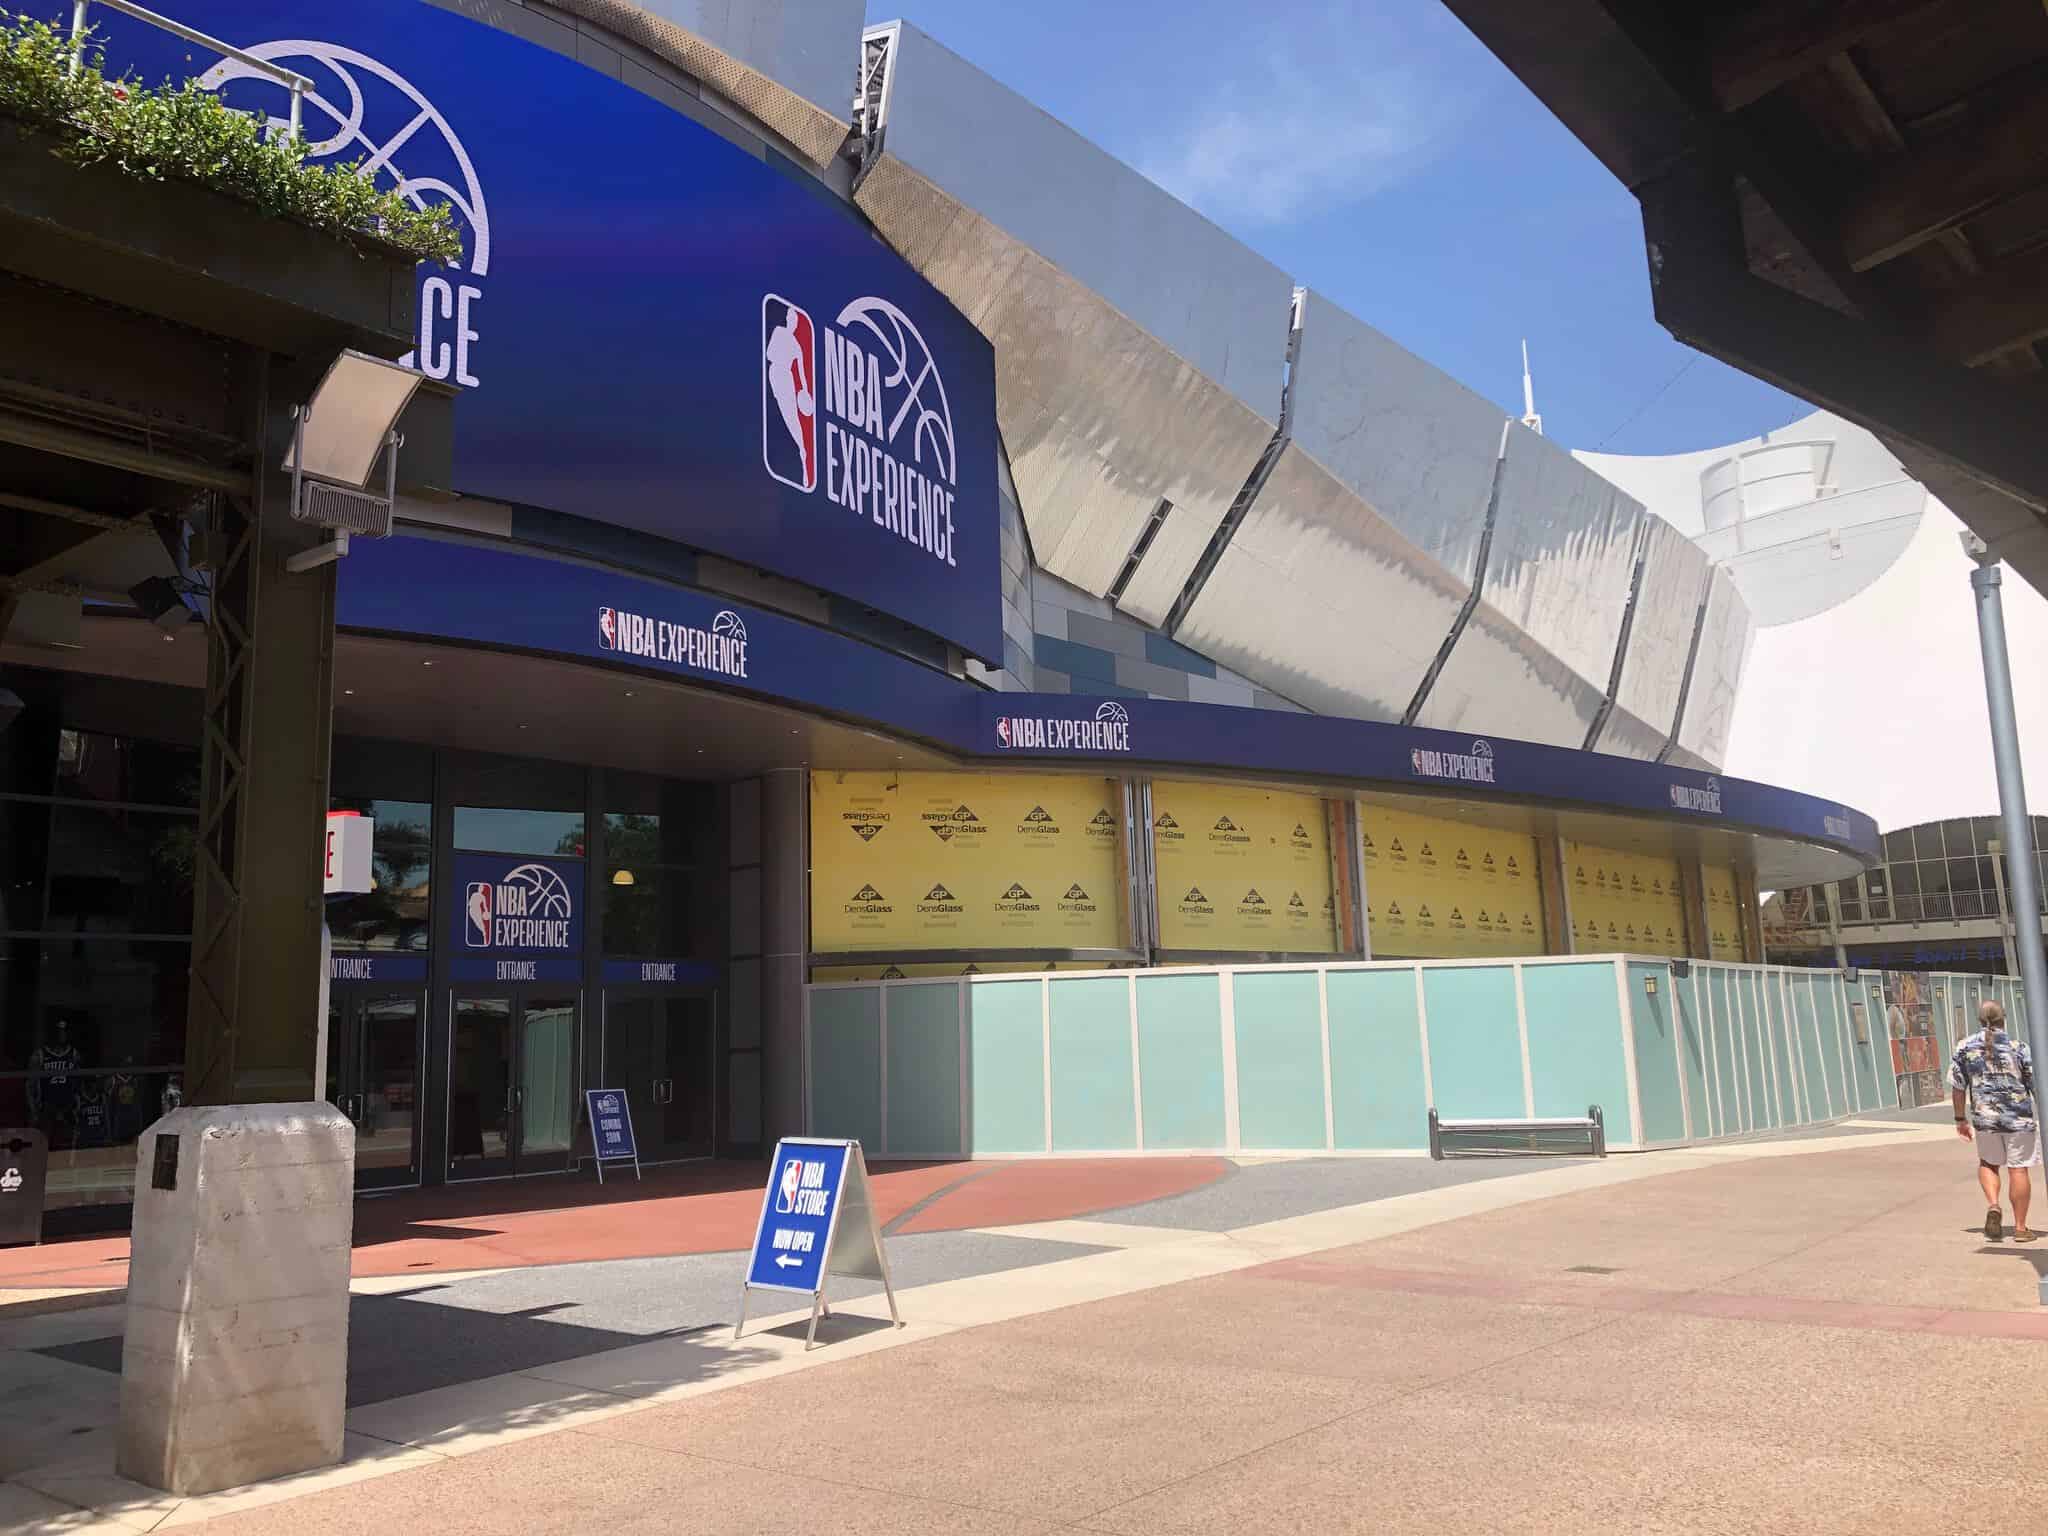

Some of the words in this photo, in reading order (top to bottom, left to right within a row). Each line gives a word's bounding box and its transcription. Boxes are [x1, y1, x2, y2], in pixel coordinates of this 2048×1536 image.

[398, 276, 481, 387] CE
[825, 326, 884, 441] NBA
[826, 421, 956, 567] EXPERIENCE
[617, 612, 656, 658] NBA
[658, 621, 748, 678] EXPERIENCE
[1012, 718, 1047, 748] NBA
[1048, 720, 1130, 750] EXPERIENCE
[1421, 750, 1443, 777] NBA
[1442, 752, 1496, 783] EXPERIENCE
[495, 885, 528, 916] NBA
[844, 903, 893, 913] DensGlass
[916, 903, 963, 913] DensGlass
[994, 903, 1040, 912] DensGlass
[495, 918, 569, 948] EXPERIENCE
[330, 958, 373, 979] NTRANCE
[496, 961, 537, 980] ENTRANCE
[641, 963, 677, 981] ENTRANCE
[800, 1162, 825, 1188] NBA
[795, 1189, 830, 1217] STORE
[772, 1229, 794, 1250] NOW
[791, 1231, 815, 1252] OPEN
